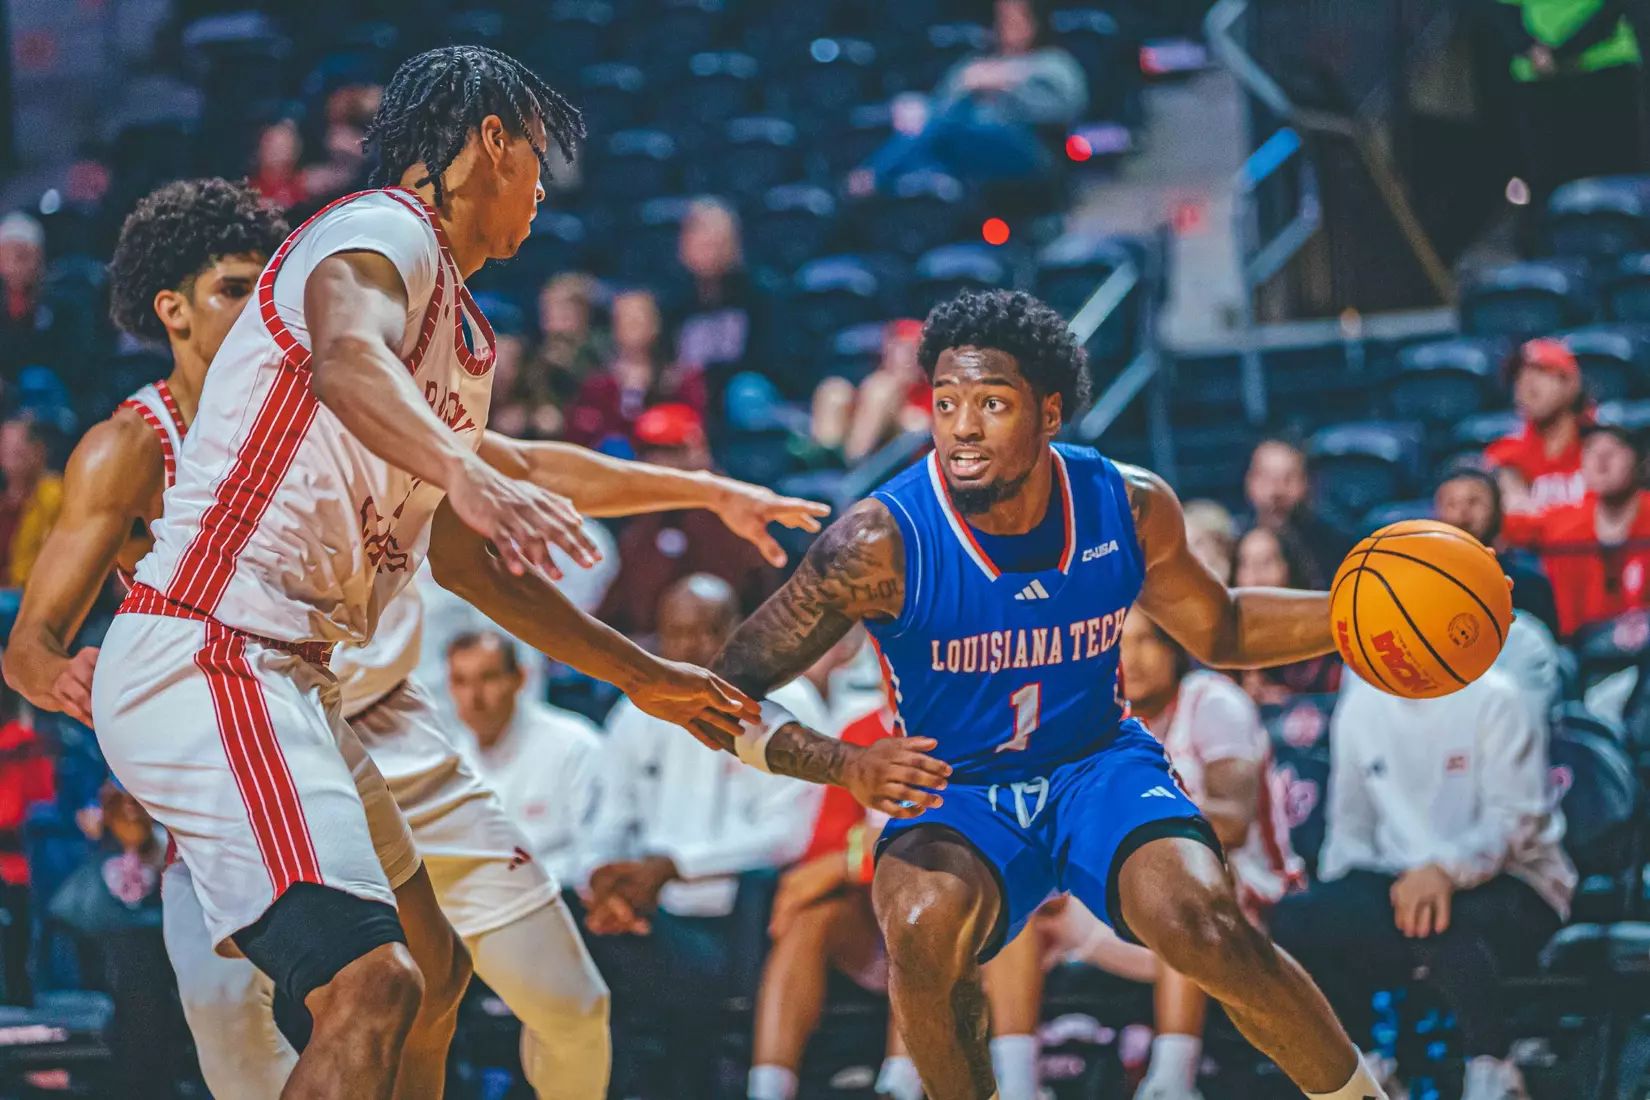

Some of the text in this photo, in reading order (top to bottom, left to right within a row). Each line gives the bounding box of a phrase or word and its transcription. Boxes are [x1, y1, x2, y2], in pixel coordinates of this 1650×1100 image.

[931, 606, 1127, 674] LOUISIANA TECH
[994, 681, 1042, 754] 1
